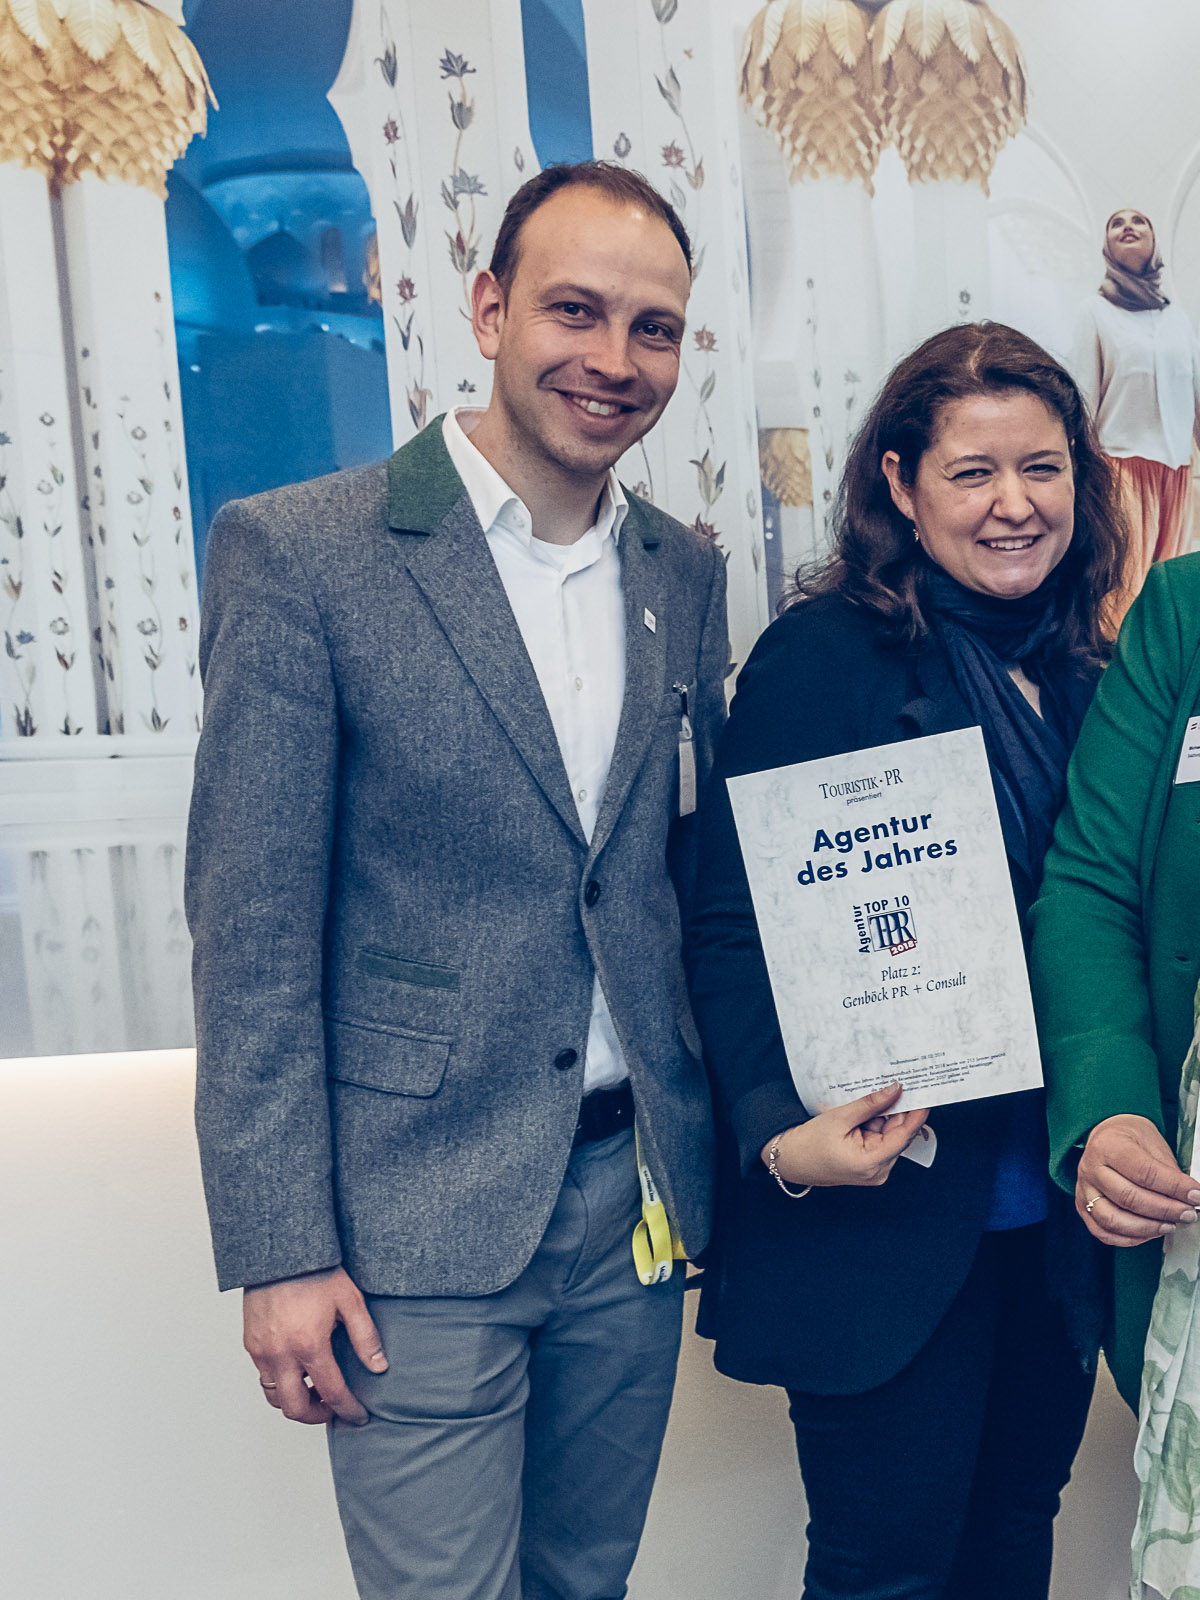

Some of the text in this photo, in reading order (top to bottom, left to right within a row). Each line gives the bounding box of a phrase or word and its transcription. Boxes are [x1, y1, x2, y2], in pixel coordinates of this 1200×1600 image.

[884, 769, 903, 785] PR
[846, 791, 883, 806] präsentiert
[814, 814, 931, 852] Agentur
[797, 840, 957, 885] des Jahres
[864, 895, 909, 913] TOP 10
[853, 906, 870, 953] Agentur
[890, 940, 915, 955] 2018
[881, 966, 920, 981] Platz 2:
[843, 972, 966, 1008] Genböck PR + Consult
